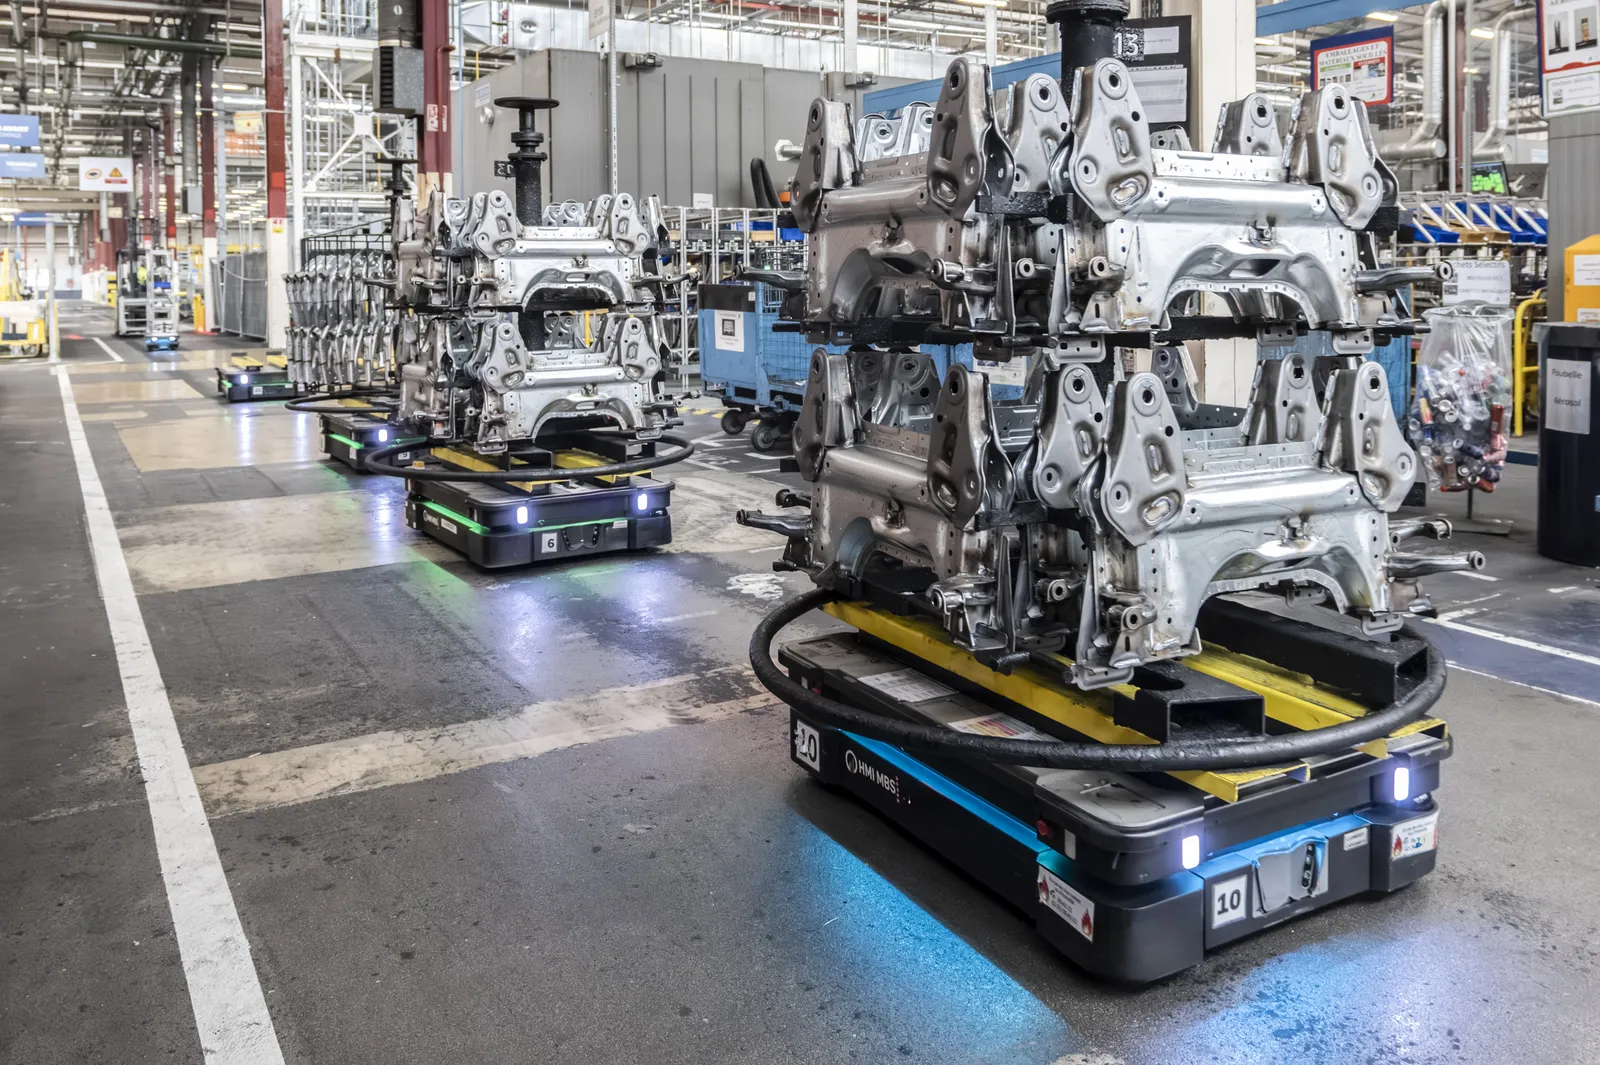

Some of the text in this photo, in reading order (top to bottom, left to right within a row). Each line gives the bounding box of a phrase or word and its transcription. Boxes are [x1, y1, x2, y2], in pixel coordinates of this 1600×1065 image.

[1115, 32, 1139, 56] 13
[1326, 43, 1379, 58] EMBALLAGES ET
[1552, 368, 1583, 379] Poubelle
[547, 538, 555, 548] 6
[858, 759, 896, 794] HMI MBS
[1217, 889, 1241, 915] 10
